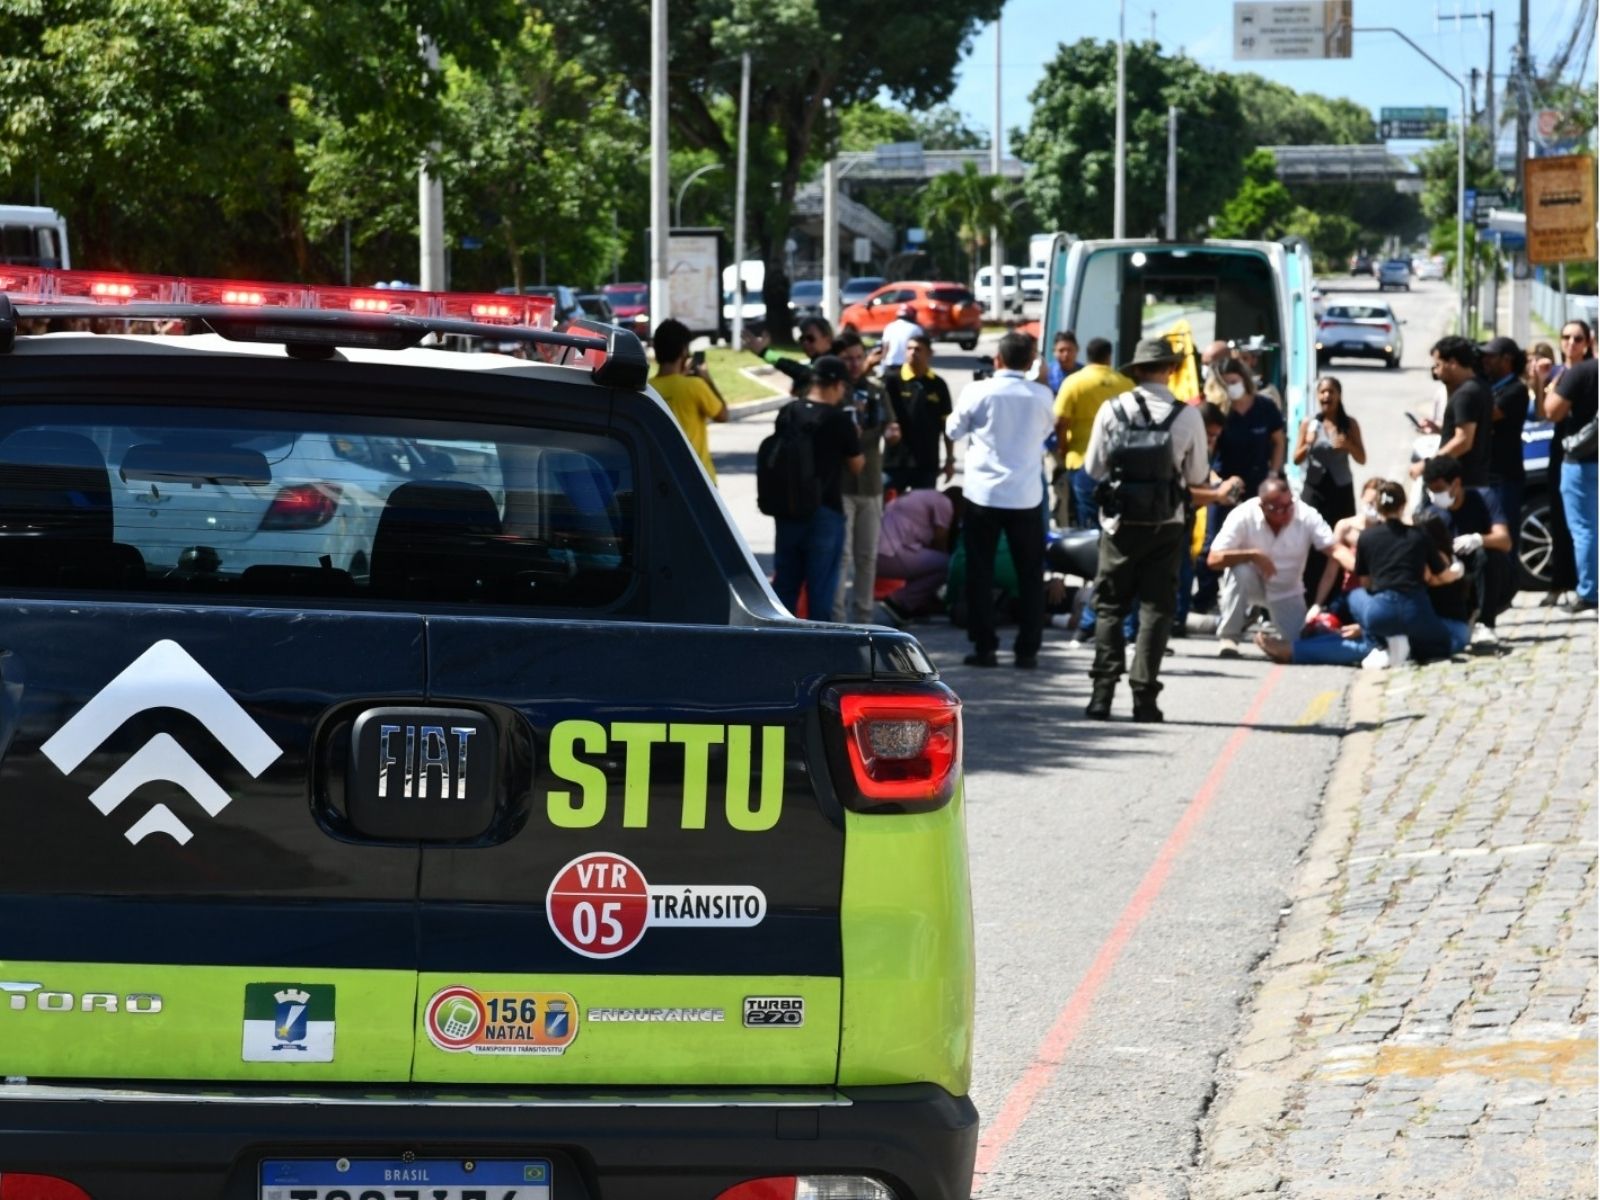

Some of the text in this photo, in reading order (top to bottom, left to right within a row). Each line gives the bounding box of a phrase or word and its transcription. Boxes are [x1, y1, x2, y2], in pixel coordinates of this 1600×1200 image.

[378, 725, 477, 800] FIAT
[546, 719, 785, 832] STTU
[576, 863, 628, 889] VTR
[651, 888, 760, 919] TRÂNSITO
[572, 901, 624, 946] 05
[0, 981, 162, 1013] TORO
[747, 1000, 803, 1010] TURBO
[486, 998, 537, 1024] 156
[587, 1008, 725, 1022] ENDURANCE
[748, 1010, 801, 1024] 270
[485, 1025, 534, 1040] NATAL
[384, 1169, 430, 1181] BRASIL
